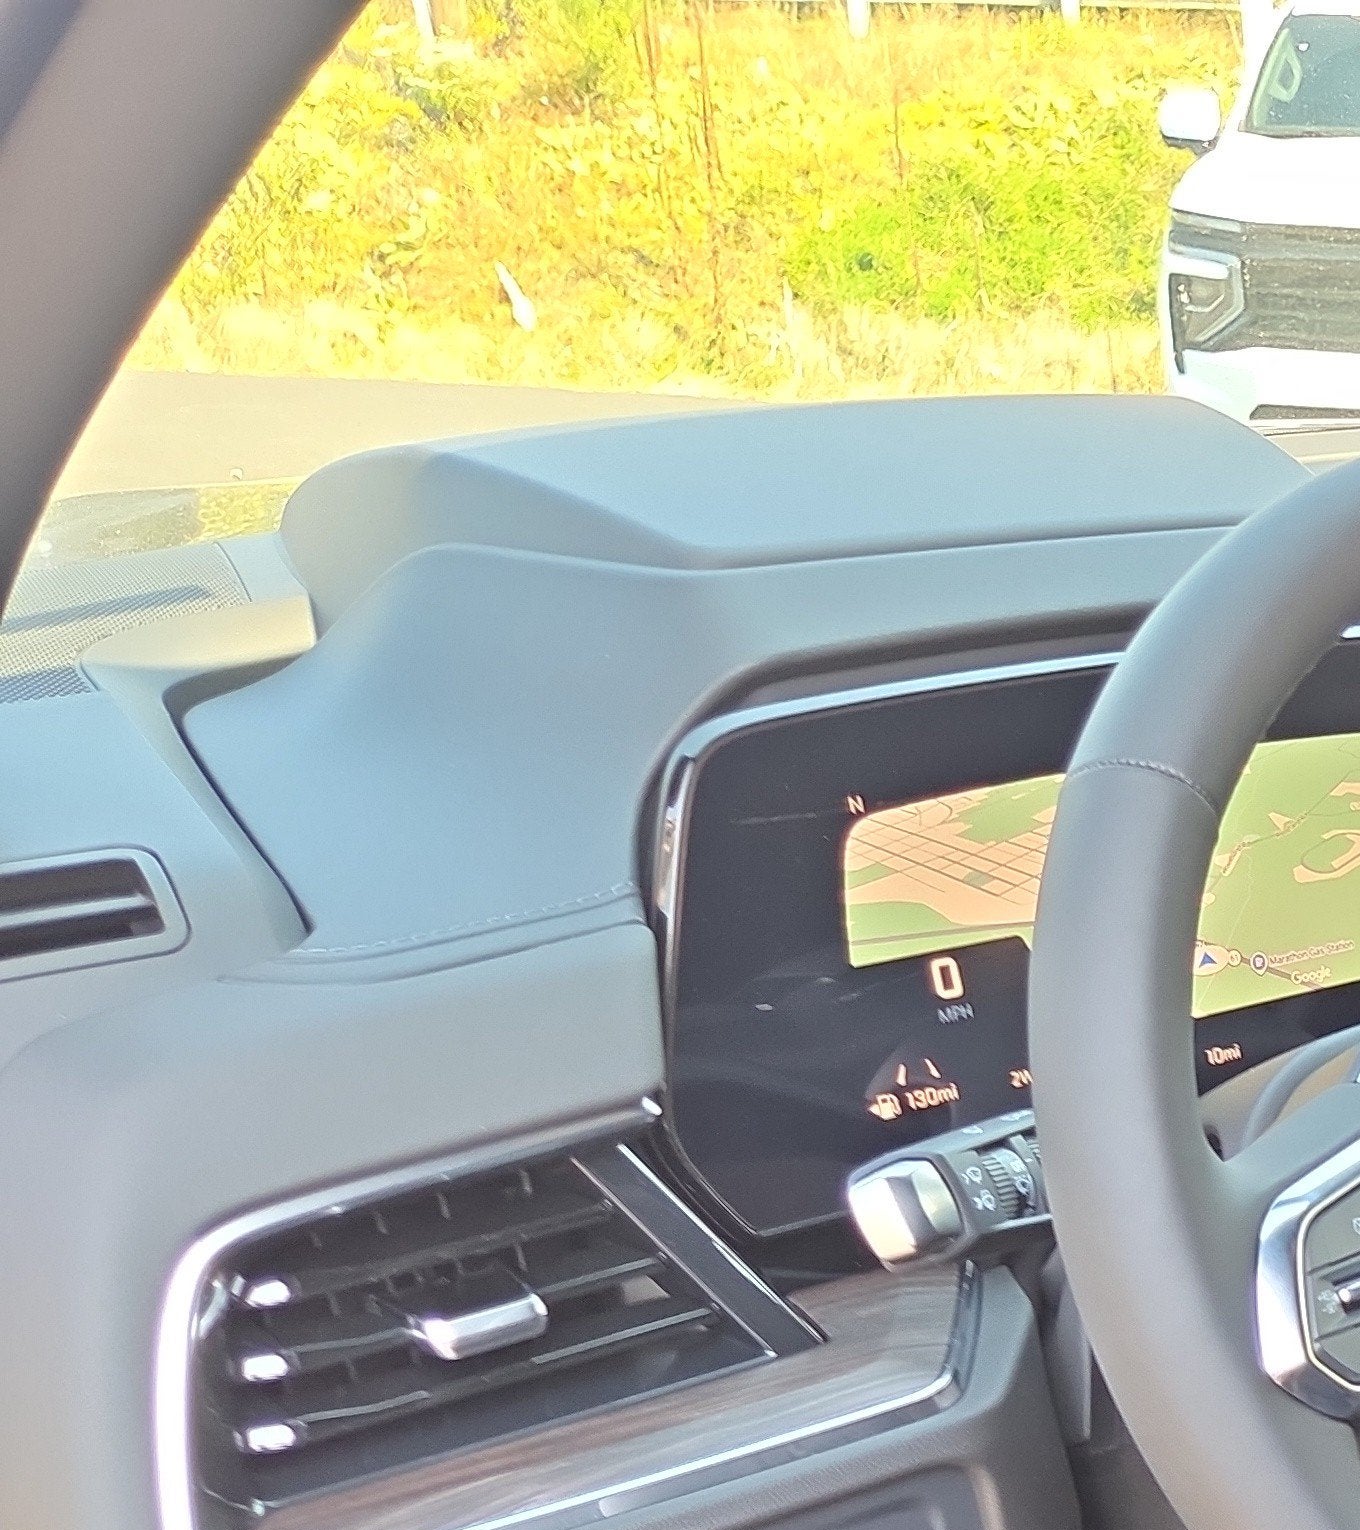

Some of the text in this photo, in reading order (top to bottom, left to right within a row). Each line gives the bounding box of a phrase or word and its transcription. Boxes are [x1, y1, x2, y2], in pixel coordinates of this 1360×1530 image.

[846, 794, 867, 816] N
[1269, 950, 1309, 965] Marathon
[1327, 940, 1355, 954] Station
[931, 956, 965, 1000] 0
[1291, 965, 1332, 985] Google
[937, 1003, 975, 1024] MPH
